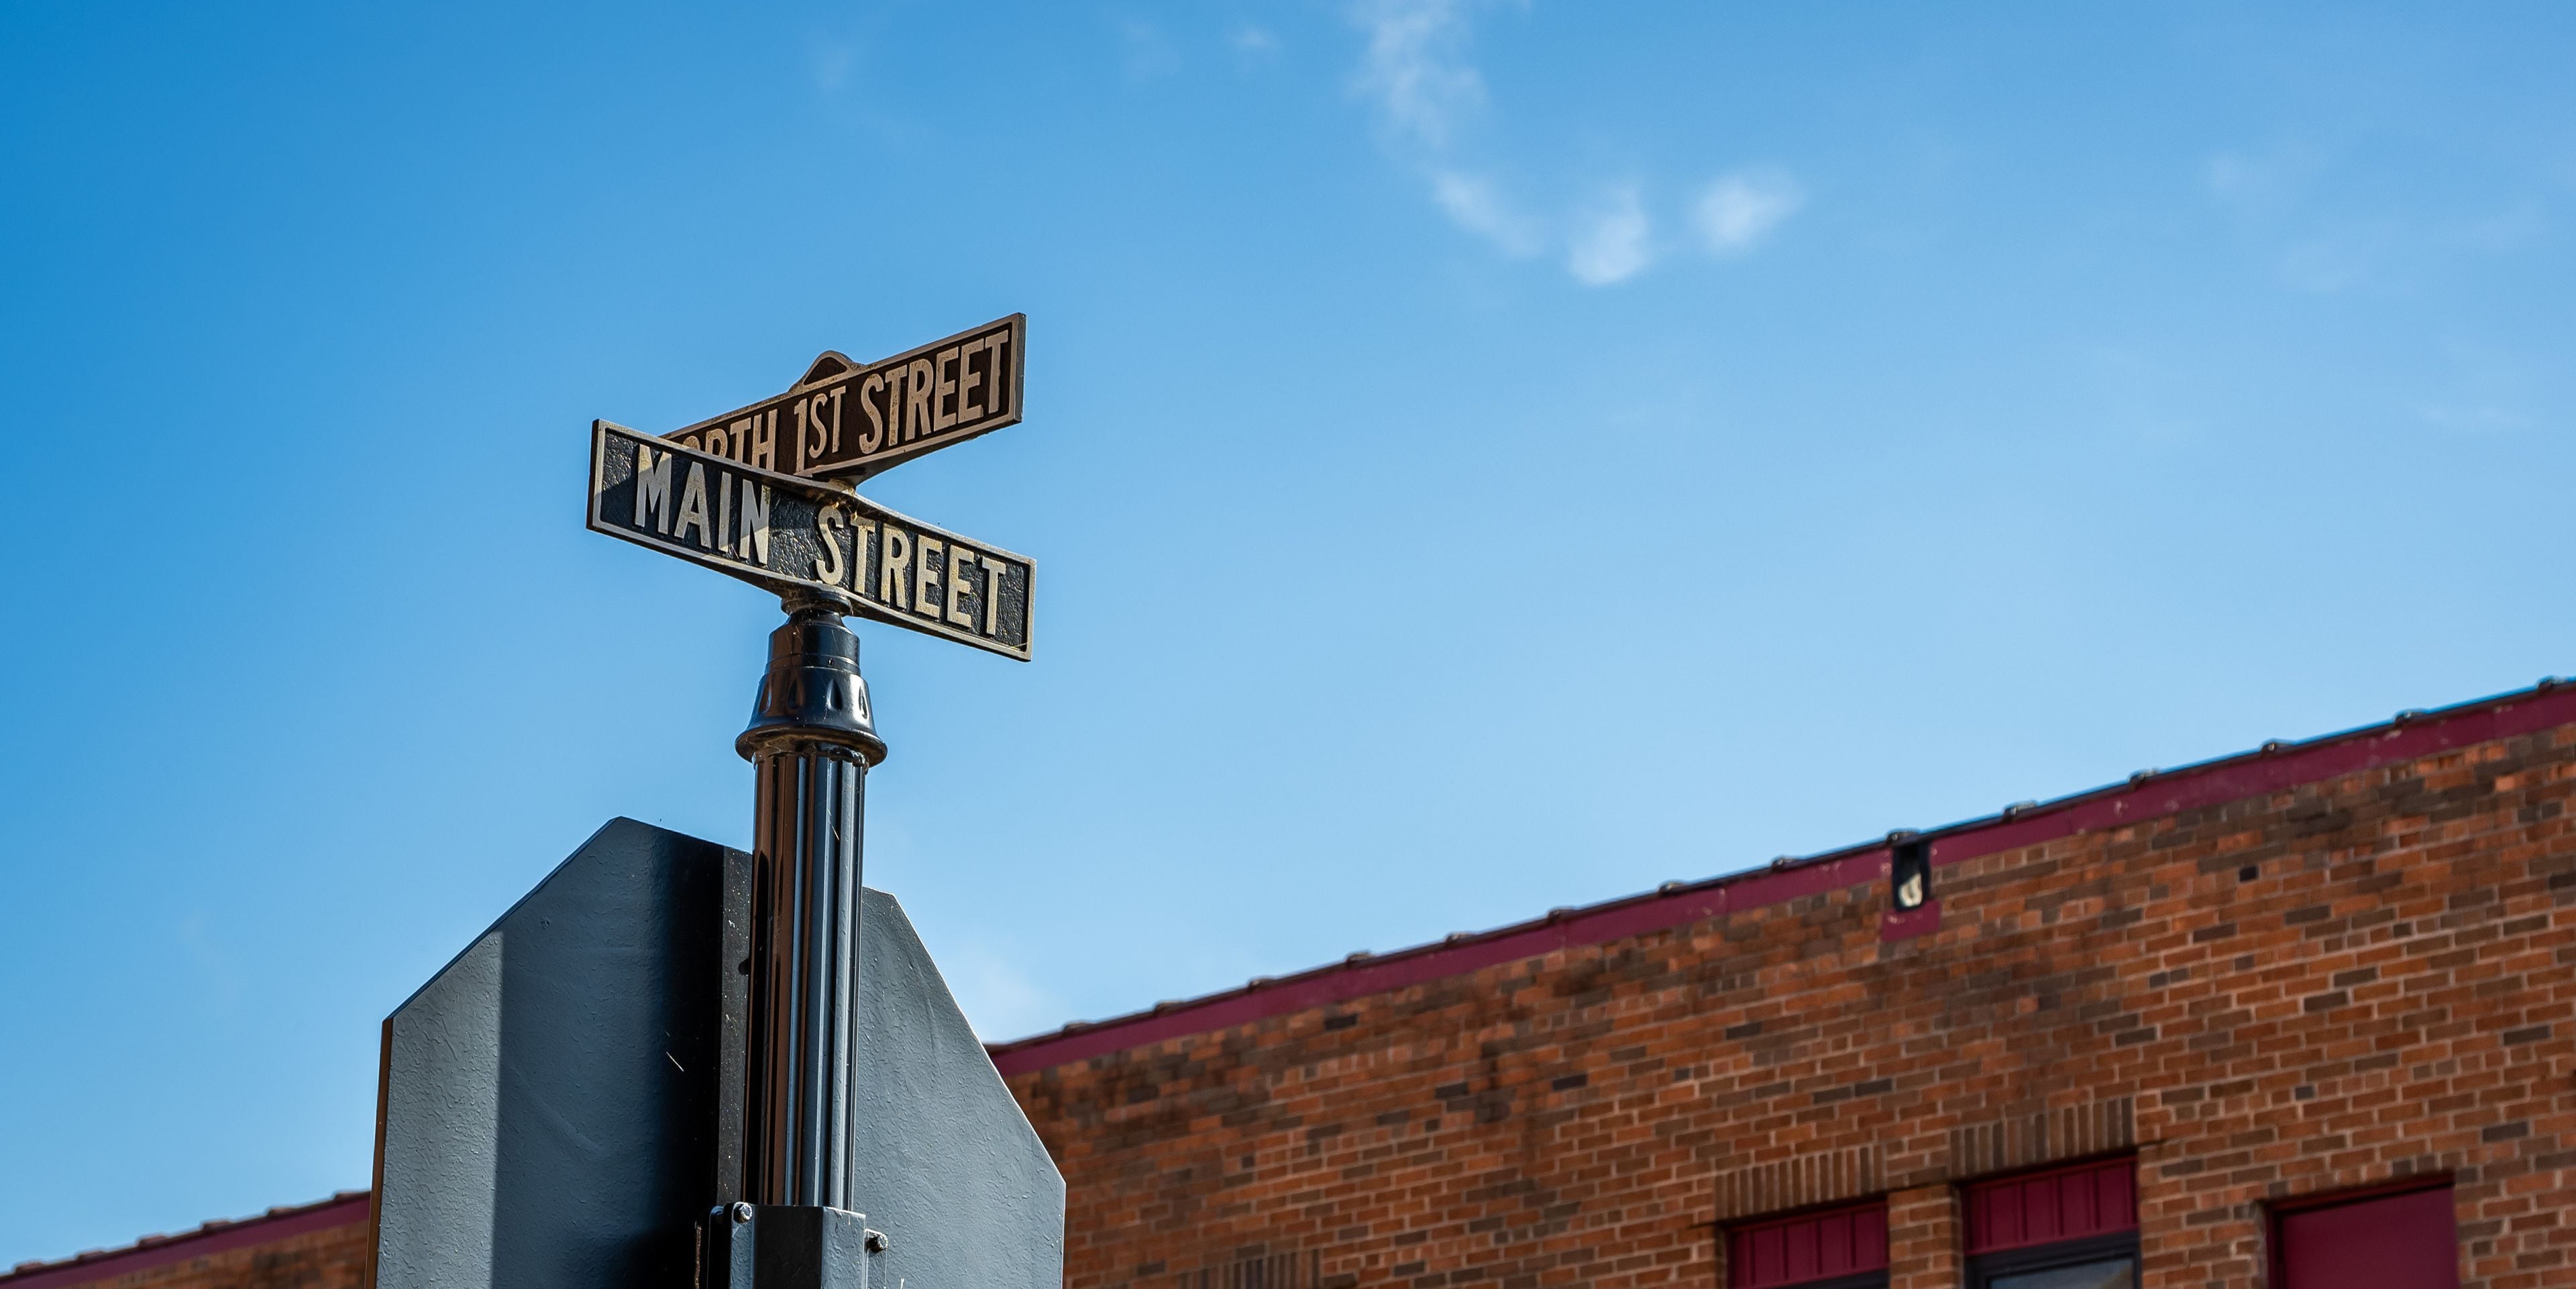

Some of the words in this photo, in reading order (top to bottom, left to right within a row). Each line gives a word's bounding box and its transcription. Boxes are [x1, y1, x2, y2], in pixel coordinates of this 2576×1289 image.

[794, 386, 846, 473] 1ST
[859, 329, 1008, 454] STREET
[635, 445, 770, 564] MAIN
[816, 506, 1006, 635] STREET
